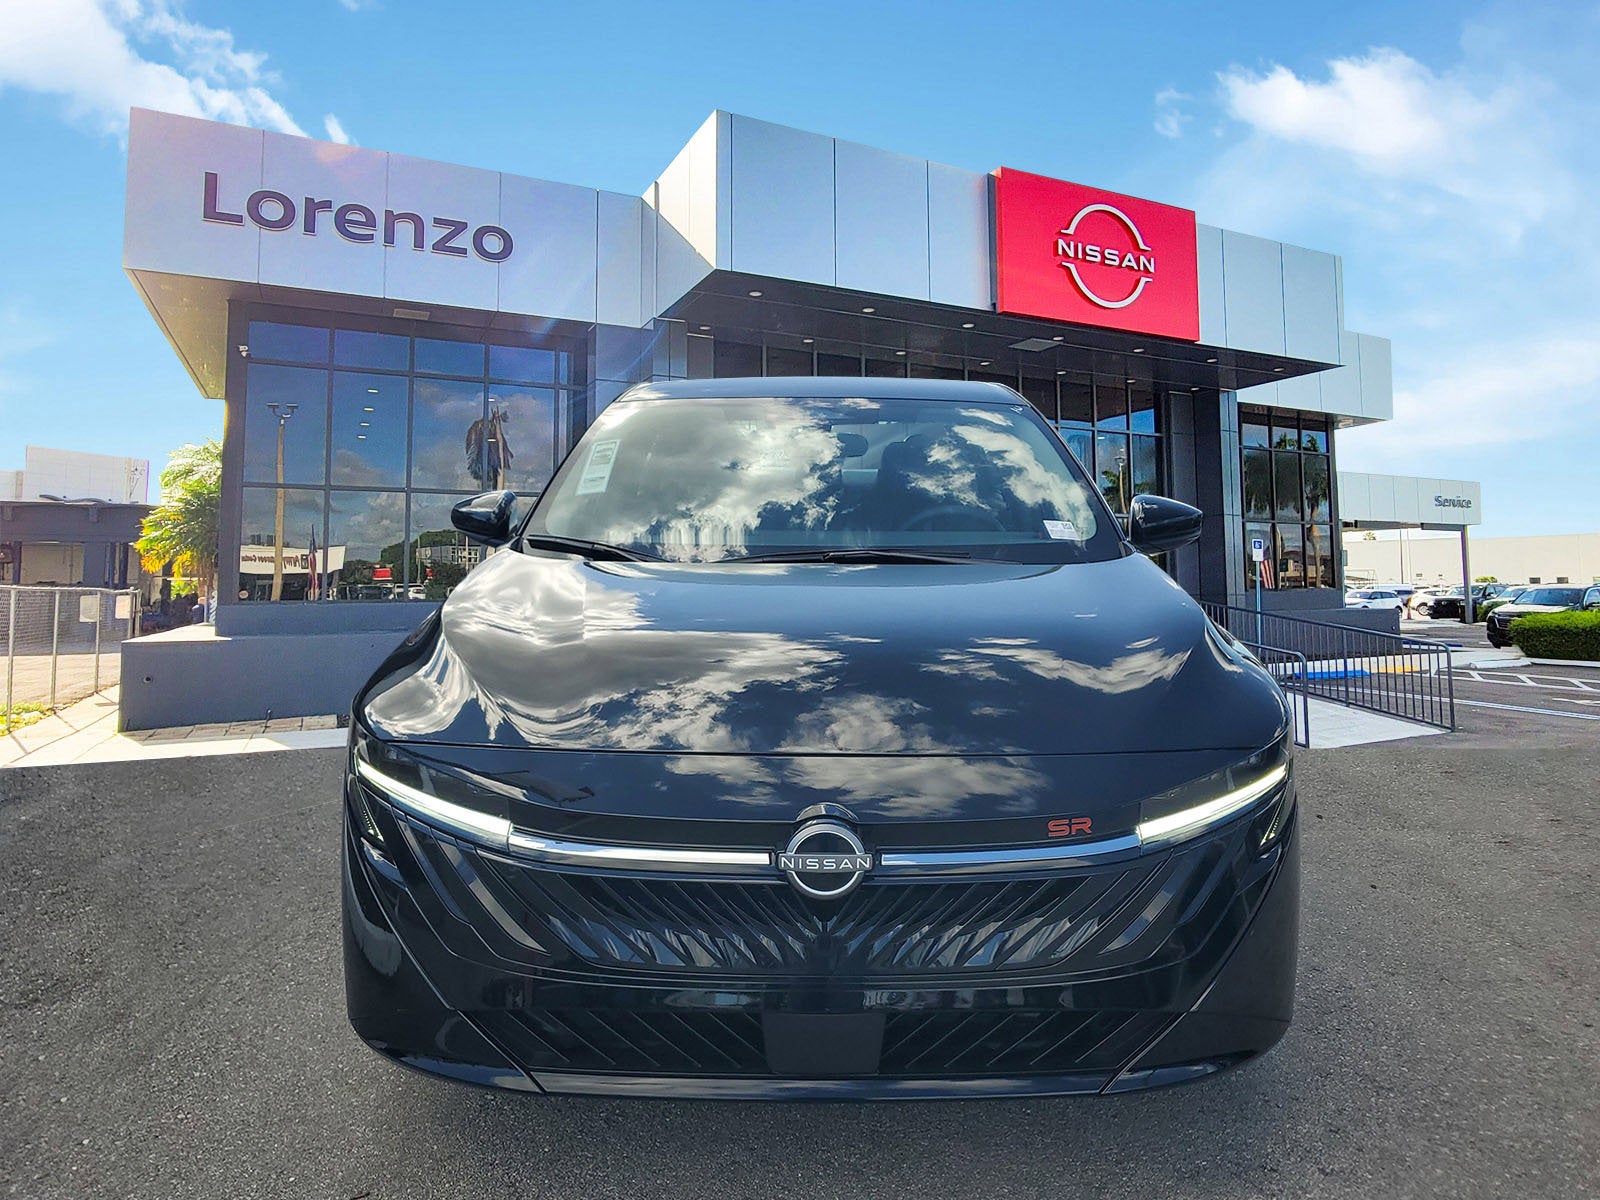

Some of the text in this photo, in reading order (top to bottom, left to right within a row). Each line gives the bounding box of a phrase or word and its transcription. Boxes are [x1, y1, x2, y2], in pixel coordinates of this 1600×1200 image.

[202, 171, 514, 263] Lorenzo
[1057, 238, 1155, 274] NISSAN
[1434, 495, 1472, 509] Service
[1047, 817, 1092, 837] SR
[781, 857, 870, 870] NISSAN
